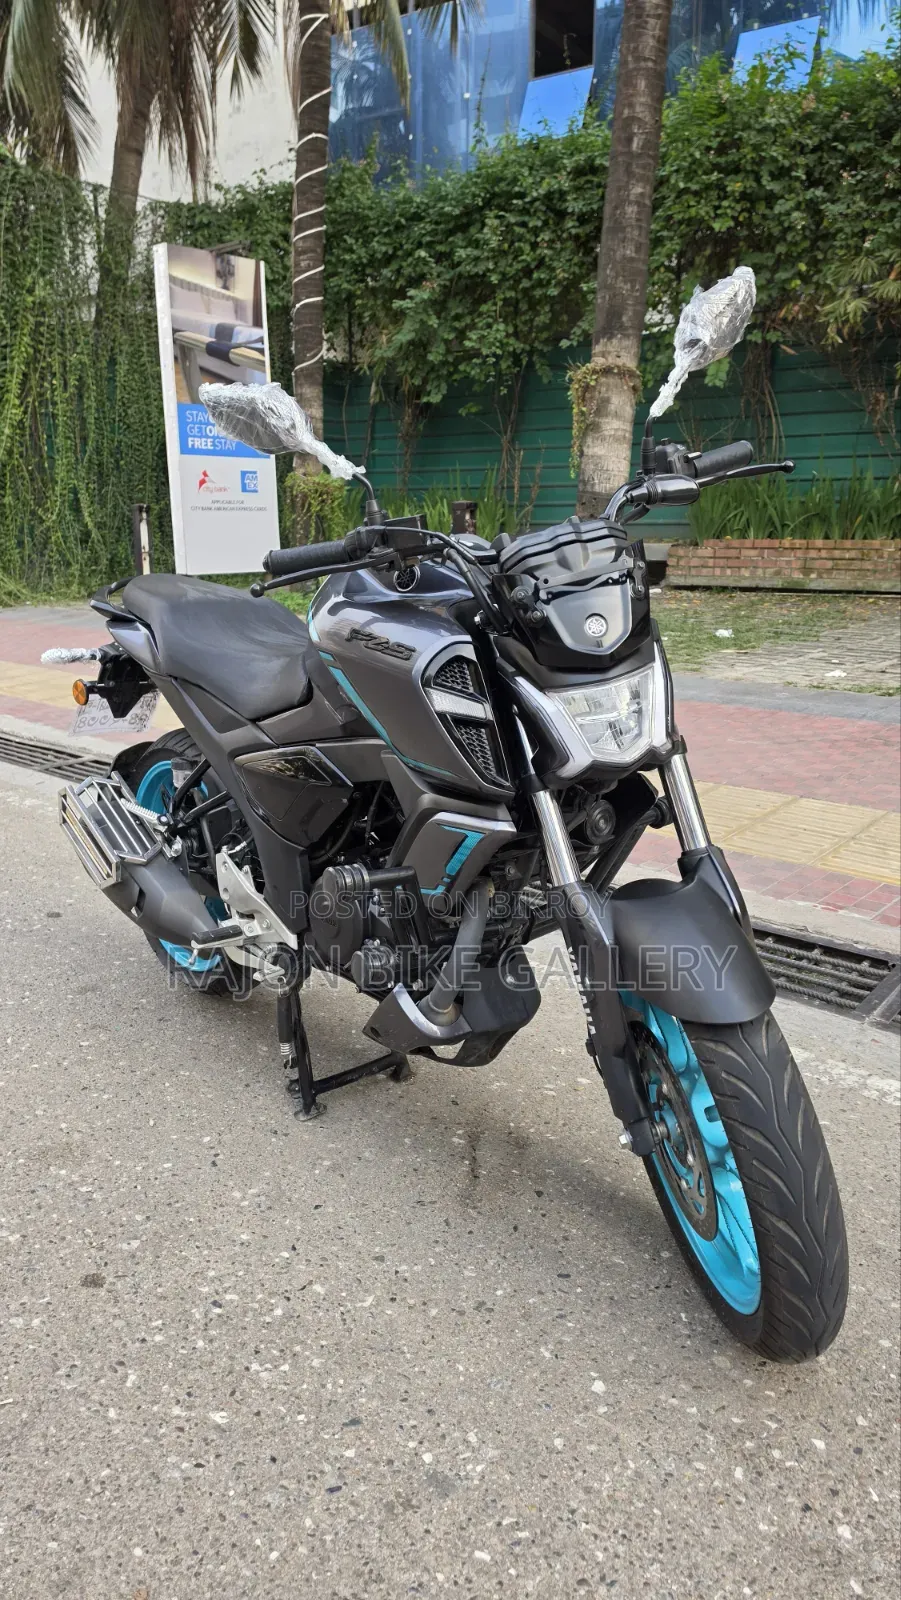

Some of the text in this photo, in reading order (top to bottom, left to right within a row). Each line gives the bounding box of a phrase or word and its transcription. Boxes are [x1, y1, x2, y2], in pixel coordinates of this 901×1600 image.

[186, 409, 208, 422] STAY
[188, 437, 237, 451] FREE STAY
[245, 474, 259, 482] AM
[203, 485, 228, 494] city bank
[247, 481, 259, 489] EX
